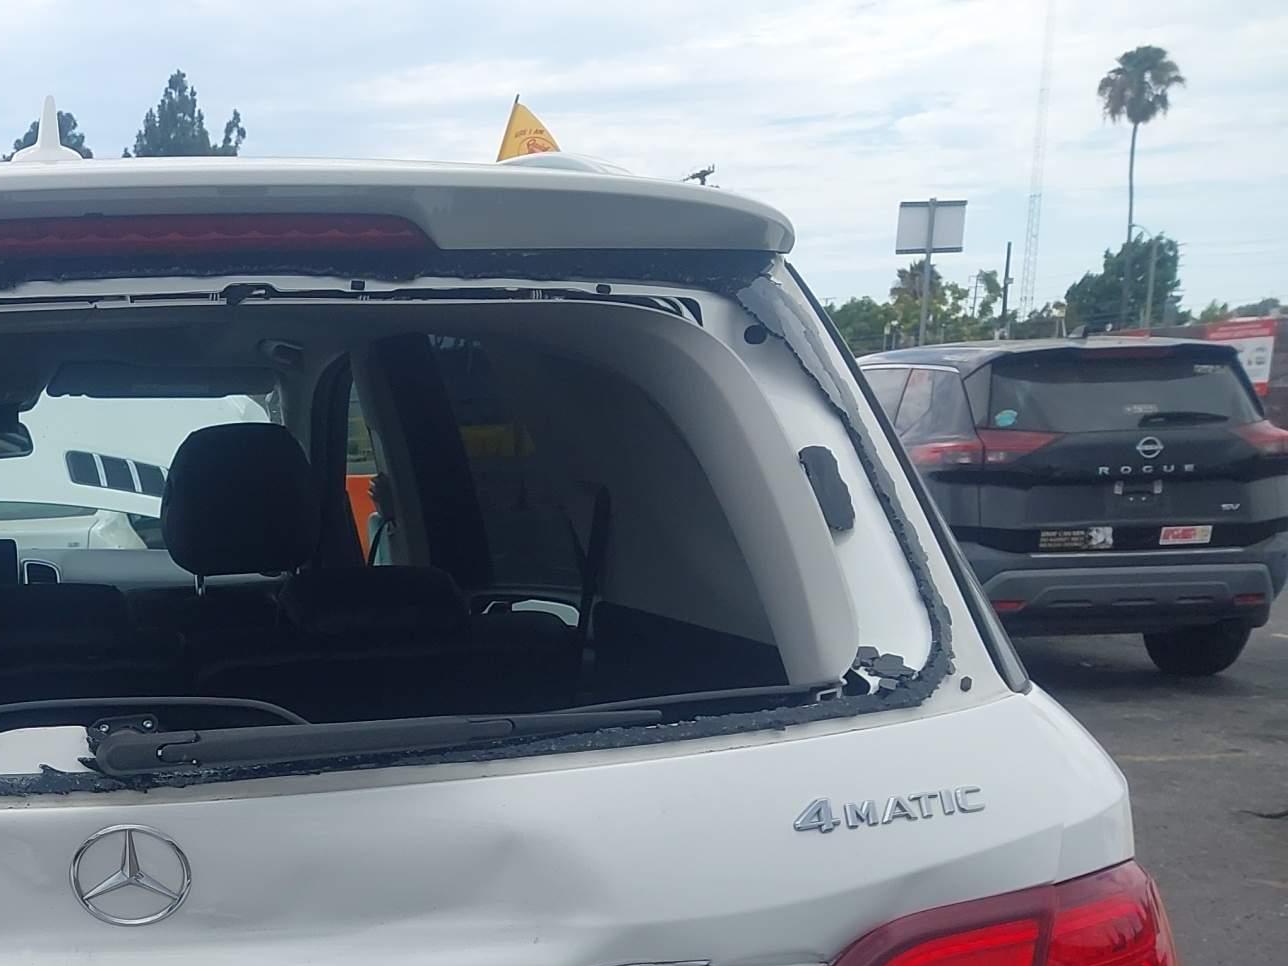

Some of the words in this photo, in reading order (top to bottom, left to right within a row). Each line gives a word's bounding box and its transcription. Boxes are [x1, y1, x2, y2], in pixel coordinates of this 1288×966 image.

[1098, 464, 1195, 475] ROGUE
[1221, 503, 1241, 511] SV
[793, 785, 985, 833] 4MATIC
